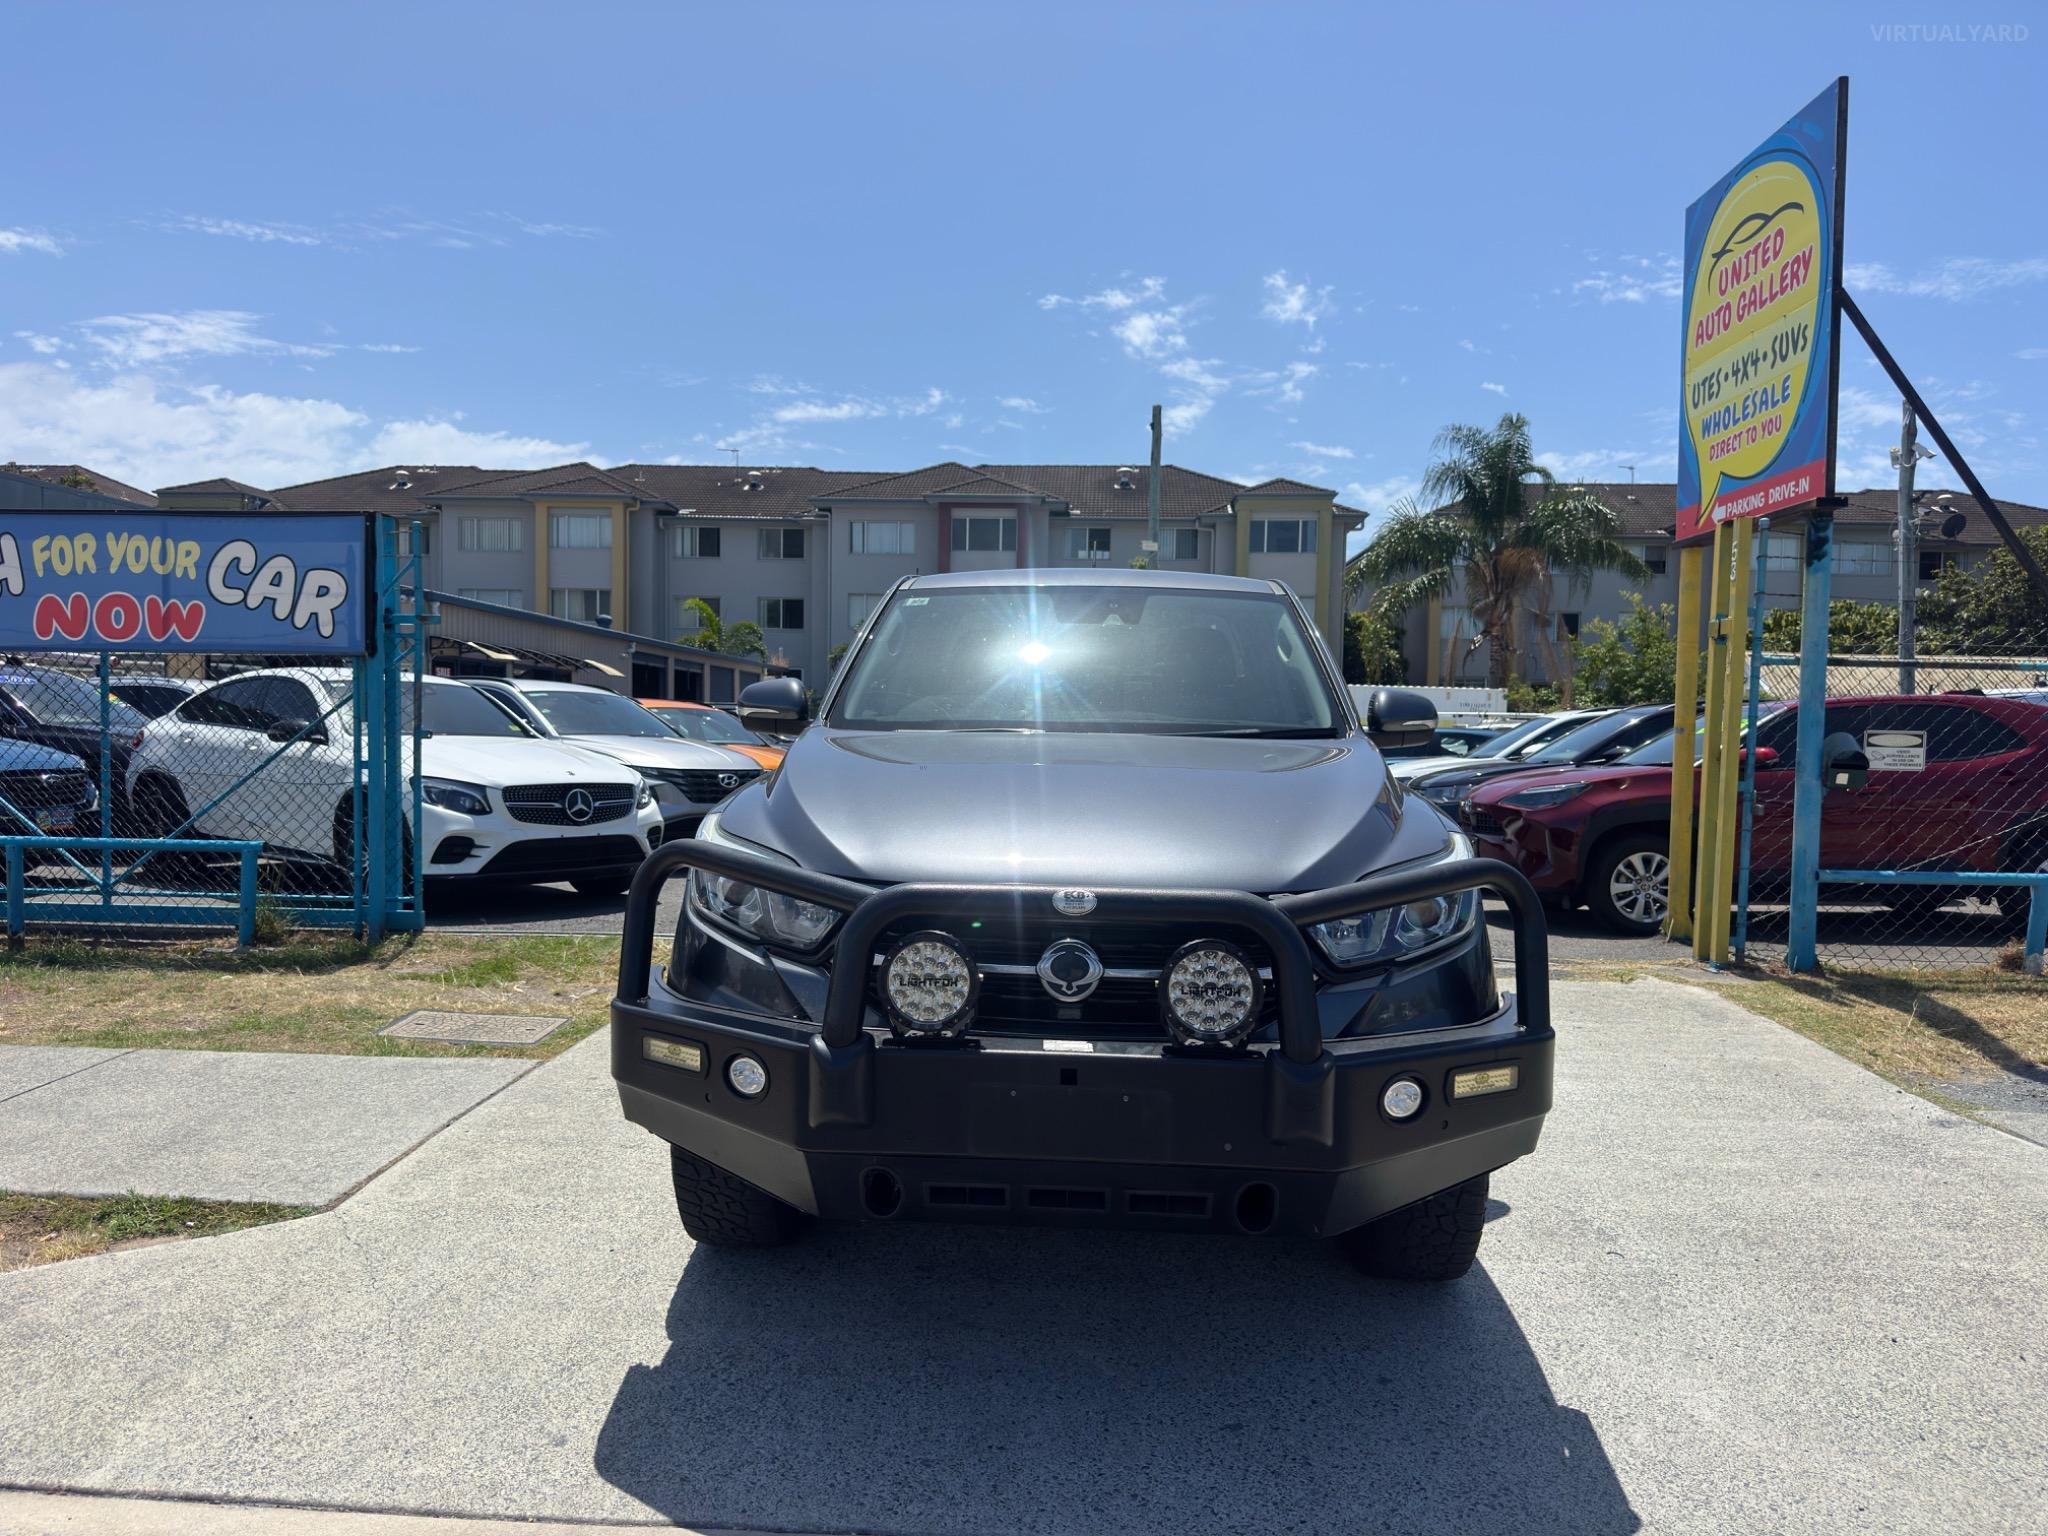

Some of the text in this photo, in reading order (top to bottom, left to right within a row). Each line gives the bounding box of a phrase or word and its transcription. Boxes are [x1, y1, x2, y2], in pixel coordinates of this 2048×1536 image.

[1718, 227, 1785, 297] UNITED
[1695, 244, 1813, 349] AUTO GALLERY
[1701, 374, 1791, 440] WHOLESALE
[1709, 413, 1782, 462] DIRECT TO YOU
[1726, 476, 1810, 518] PARKING DRIVE-IN
[32, 532, 97, 579] FOR
[106, 531, 201, 581] YOUR
[206, 538, 348, 639] CAR
[33, 591, 206, 643] NOW
[1063, 891, 1086, 900] ECB
